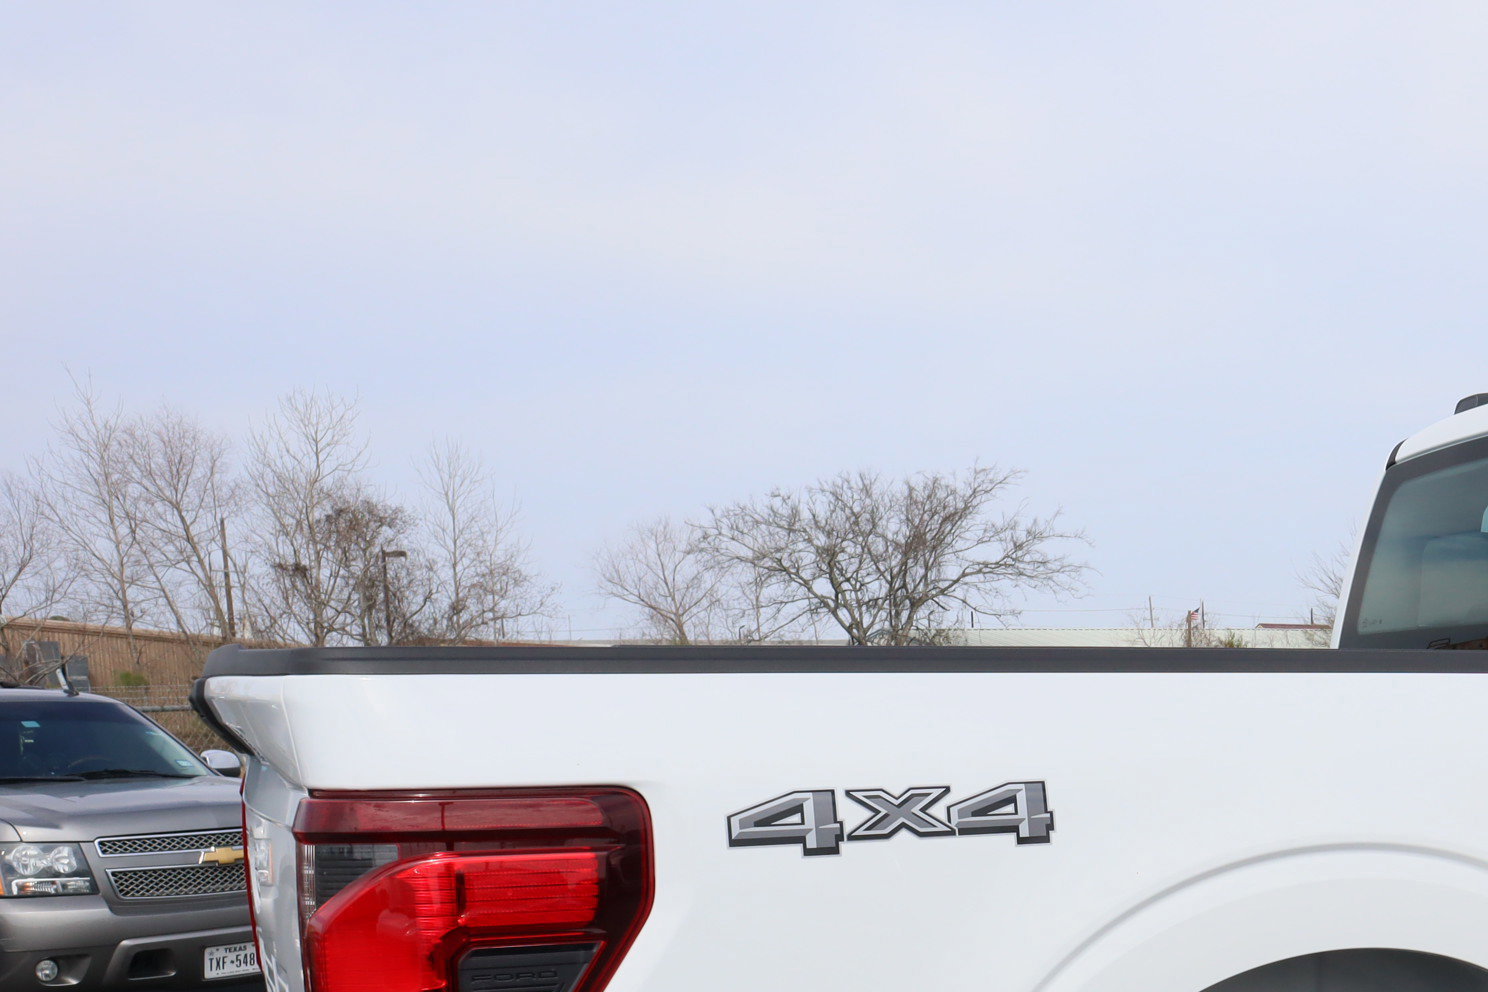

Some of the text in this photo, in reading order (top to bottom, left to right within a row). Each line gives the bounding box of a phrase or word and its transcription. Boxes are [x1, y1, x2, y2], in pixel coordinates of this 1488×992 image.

[727, 781, 1055, 857] 4X4
[224, 945, 247, 954] TEXAS
[472, 971, 559, 984] FORD
